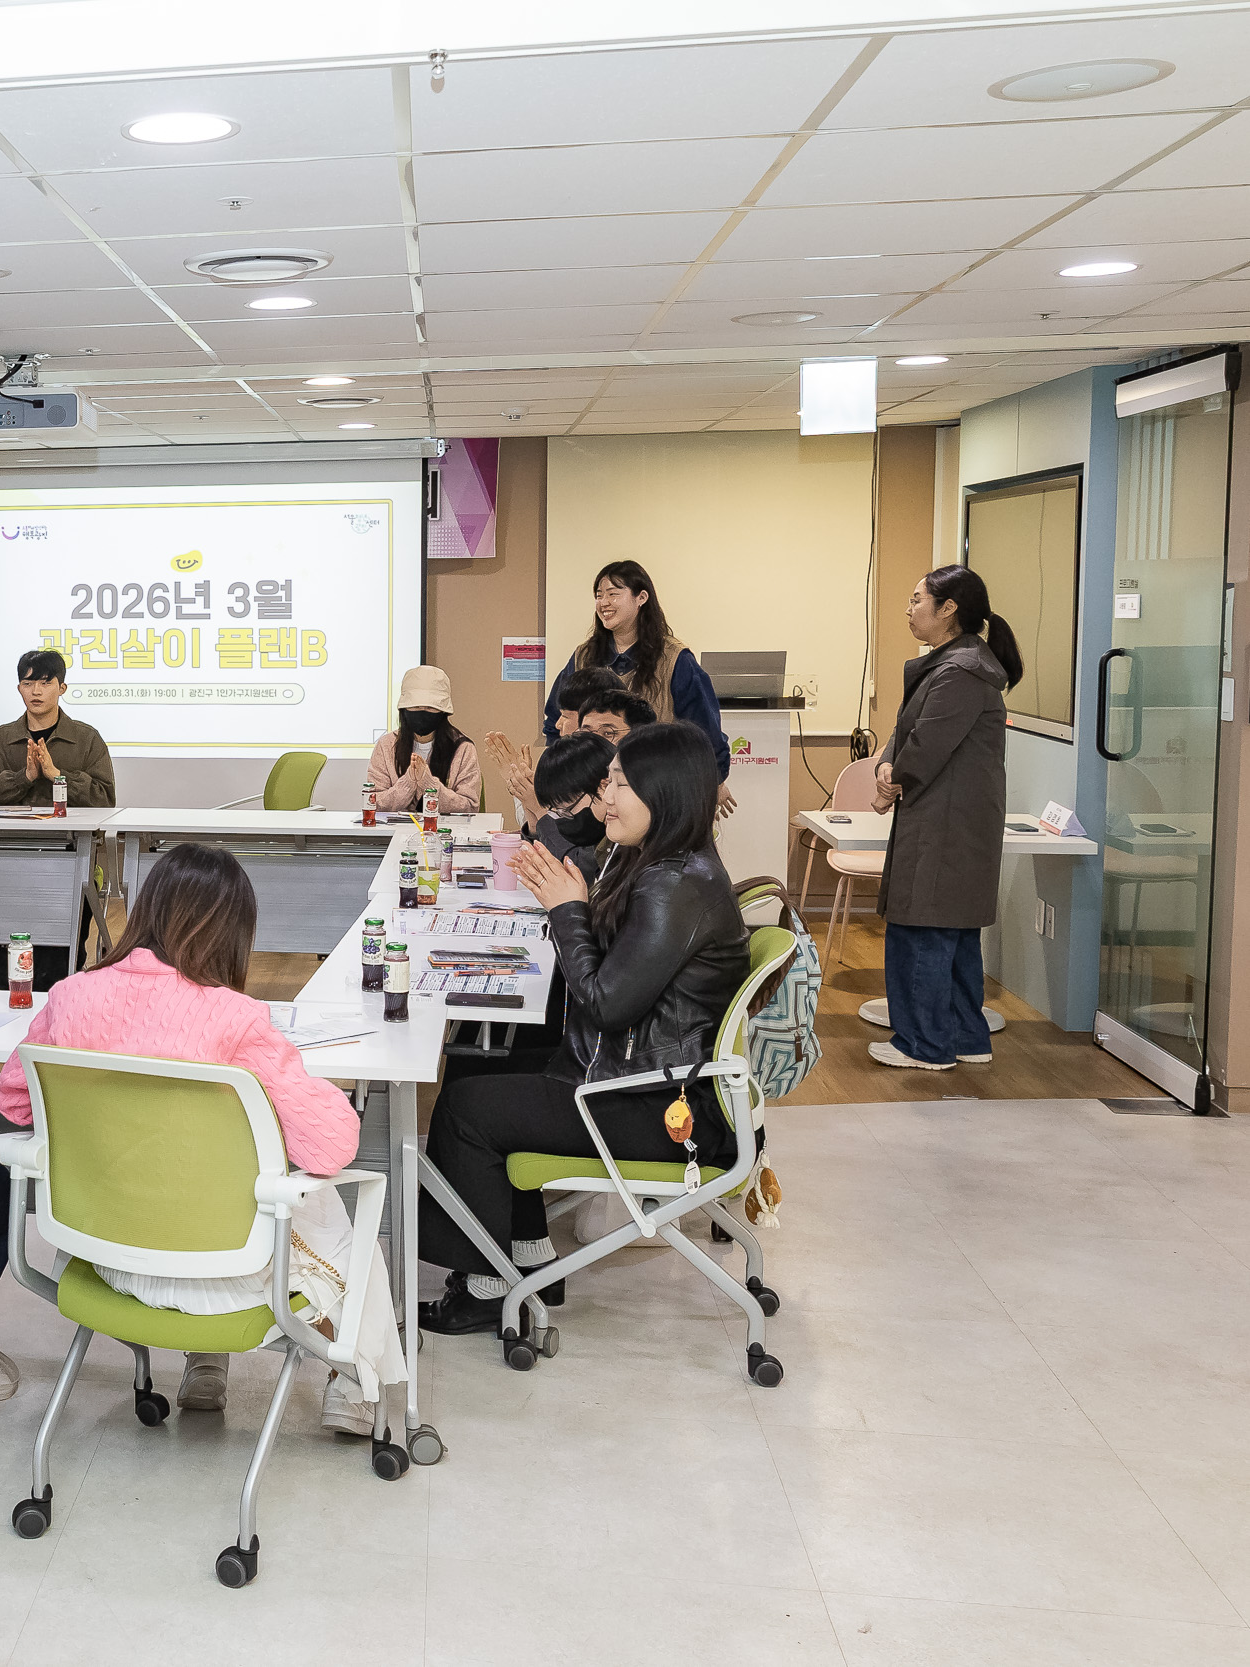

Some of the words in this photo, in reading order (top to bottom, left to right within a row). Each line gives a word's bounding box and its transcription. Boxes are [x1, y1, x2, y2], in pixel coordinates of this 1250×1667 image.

[70, 580, 211, 620] 2026년
[226, 579, 293, 620] 3월
[37, 628, 201, 669] 광진살이
[215, 627, 328, 669] 플랜B
[87, 689, 151, 698] 2026.03.31.(화)
[154, 688, 177, 698] 19:00
[189, 688, 213, 698] 광진구
[216, 688, 278, 698] 1인가구지원센터
